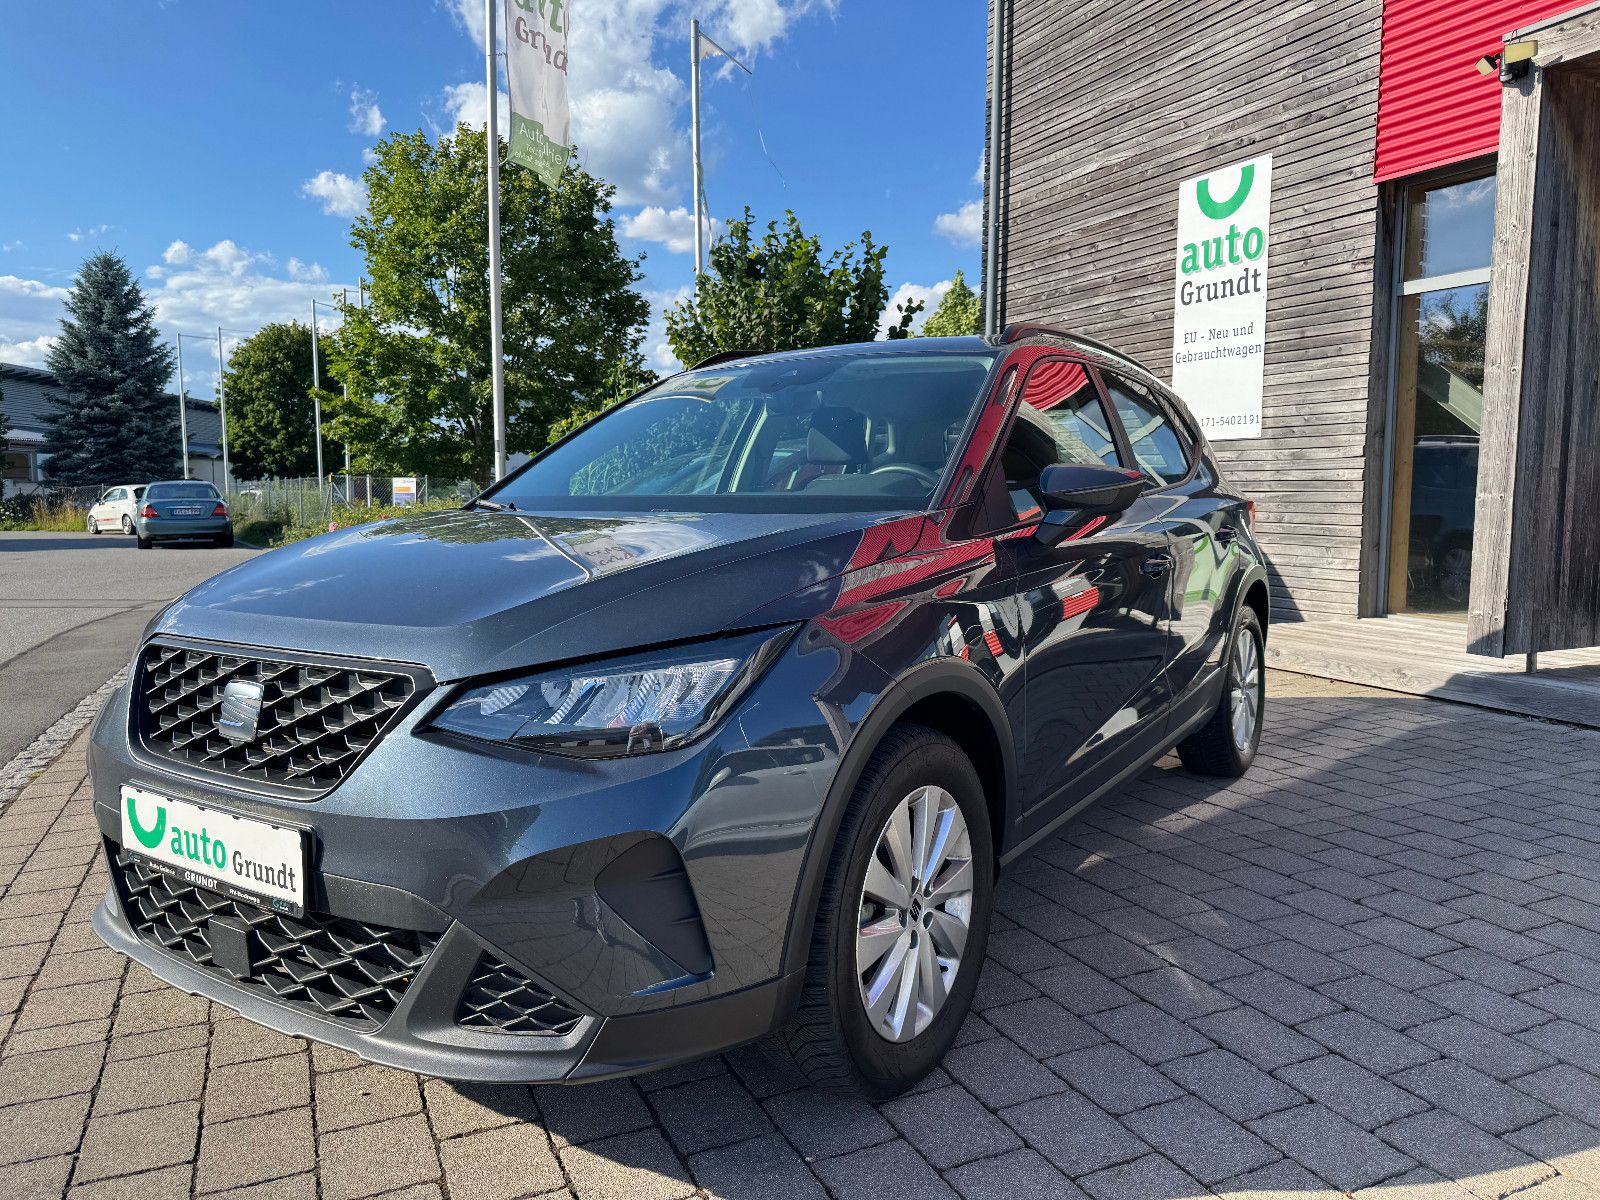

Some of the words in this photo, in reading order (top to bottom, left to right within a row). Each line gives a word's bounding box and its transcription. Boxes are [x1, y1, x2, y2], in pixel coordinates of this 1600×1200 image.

[1181, 224, 1265, 275] auto
[1181, 268, 1261, 306] Grundt
[1183, 331, 1198, 345] EU
[1208, 328, 1229, 341] Neu
[1233, 321, 1254, 337] und
[1175, 343, 1262, 364] Gebrauchtwagen
[170, 827, 227, 869] auto
[232, 850, 297, 893] Grundt
[184, 870, 218, 890] GRUNDT
